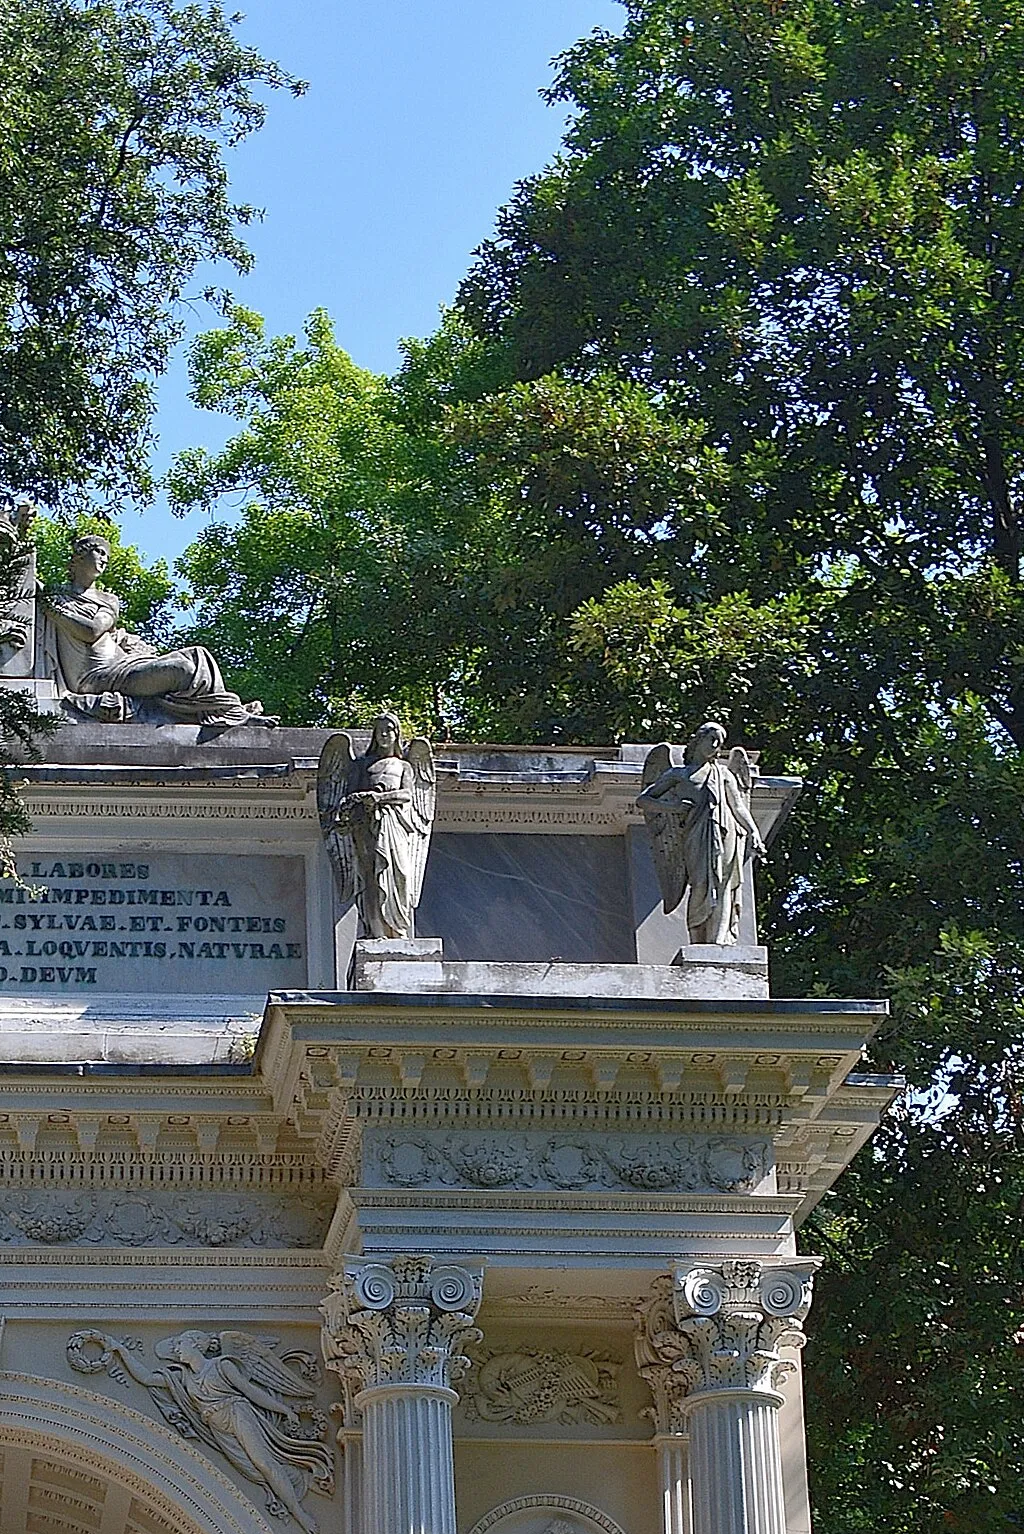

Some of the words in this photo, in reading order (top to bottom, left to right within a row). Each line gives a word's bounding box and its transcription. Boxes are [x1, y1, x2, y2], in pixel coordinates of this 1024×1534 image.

[31, 862, 150, 879] LABORES
[40, 888, 232, 907] IMPEDIMENTA
[176, 917, 287, 933] FONTEIS
[178, 942, 302, 959] NATVRAE
[20, 966, 97, 984] DEVM
